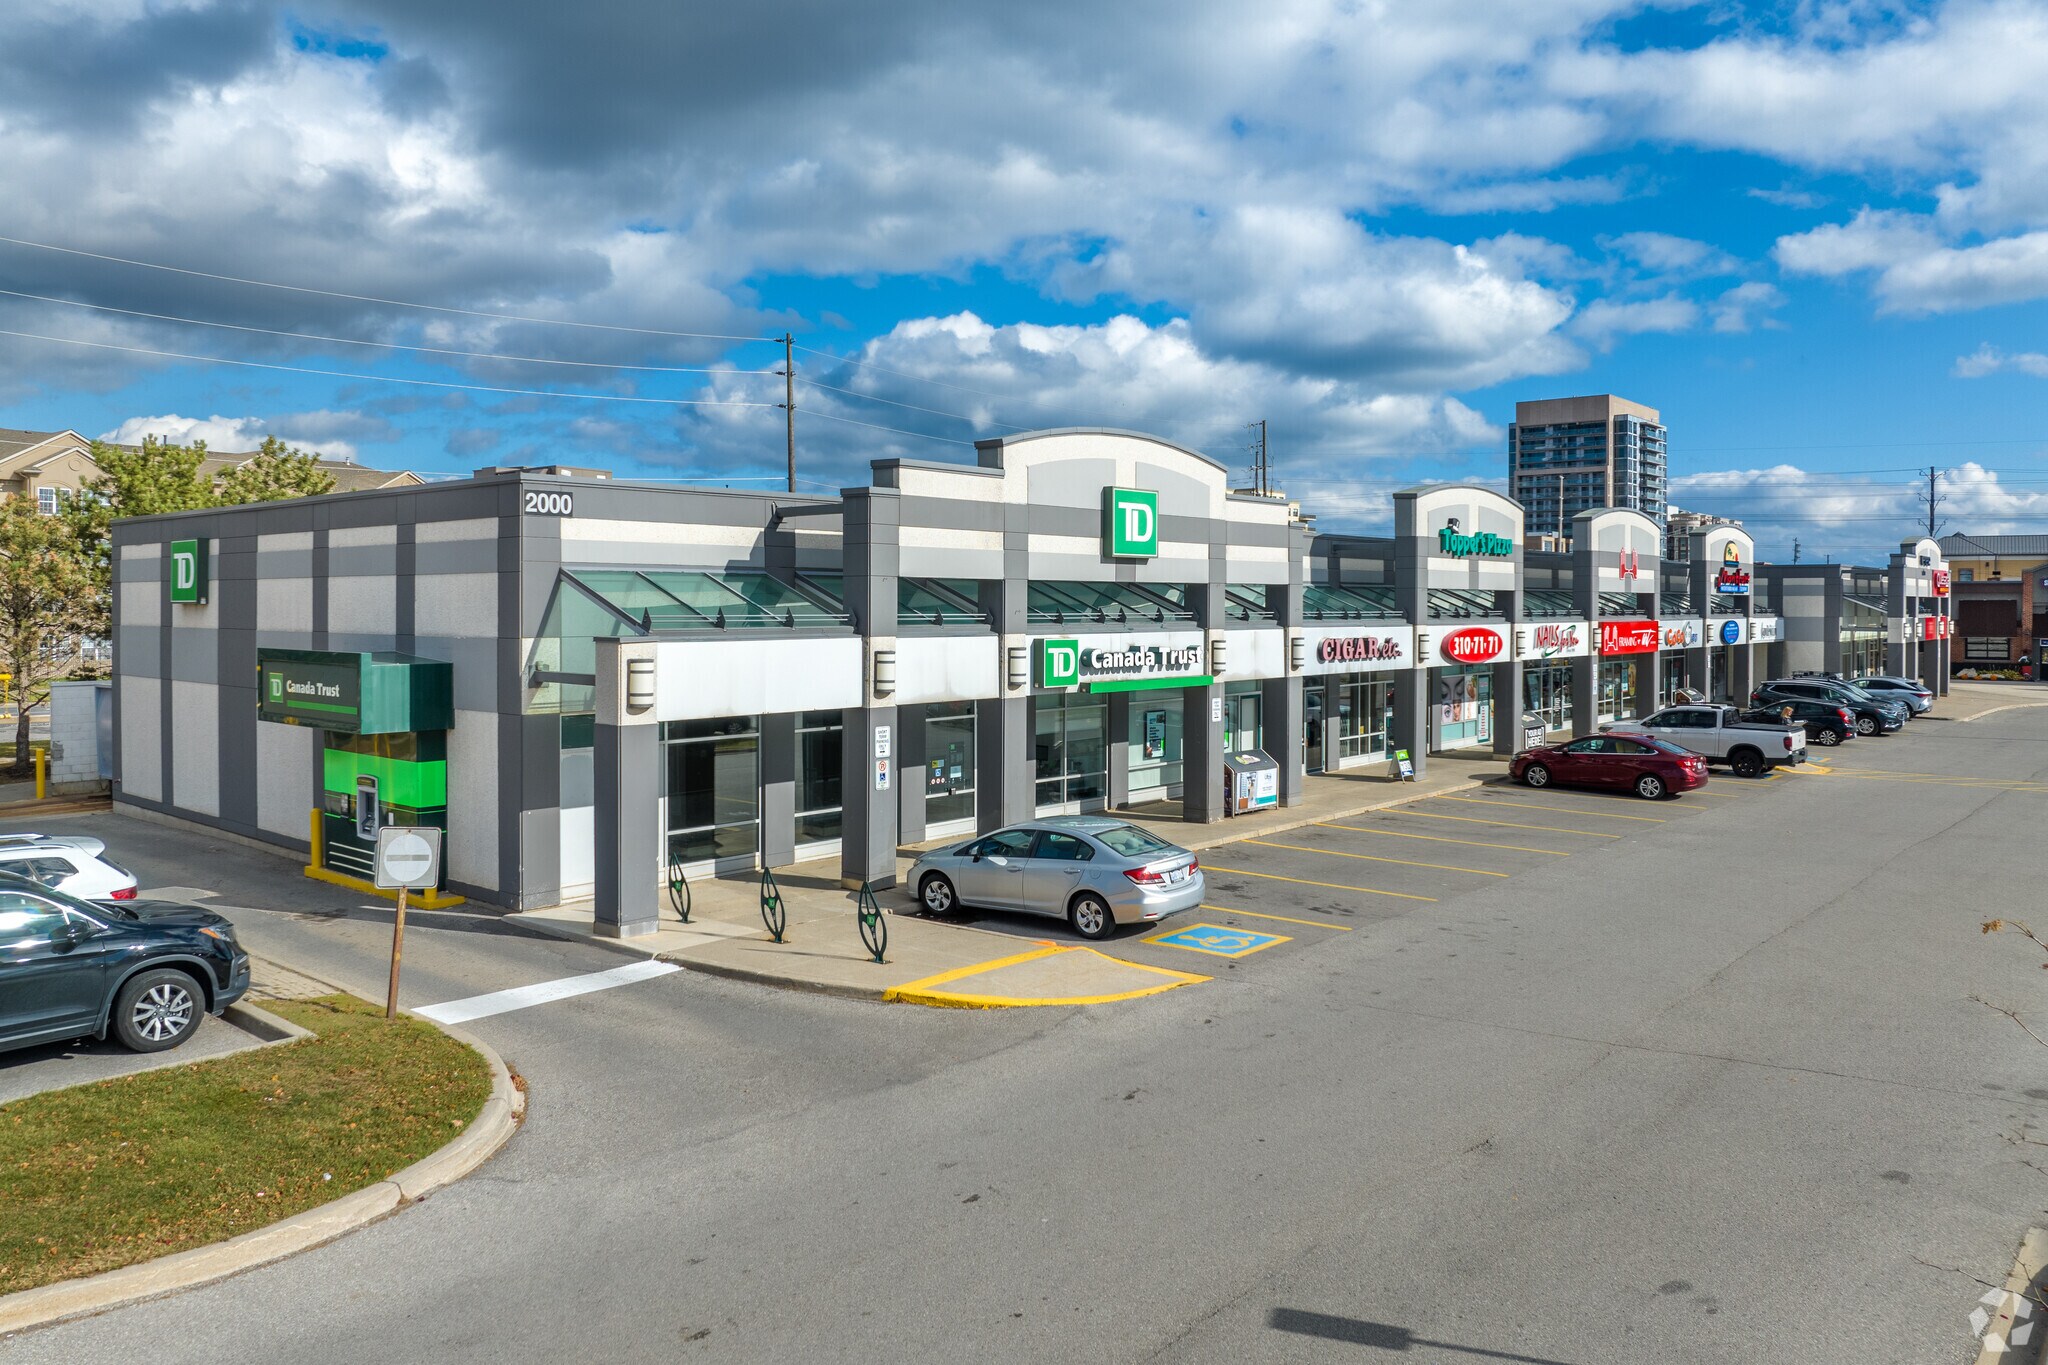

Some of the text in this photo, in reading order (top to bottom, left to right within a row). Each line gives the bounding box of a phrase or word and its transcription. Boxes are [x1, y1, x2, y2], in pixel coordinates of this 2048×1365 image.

[525, 492, 572, 515] 2000
[1118, 502, 1154, 543] TD
[1483, 533, 1513, 554] Pizza
[173, 552, 195, 589] TD
[1321, 637, 1403, 661] CIGAR etc.
[1536, 625, 1560, 649] NAILS
[1047, 645, 1203, 678] TD Canada Trust
[270, 678, 340, 698] TD Canada Trust
